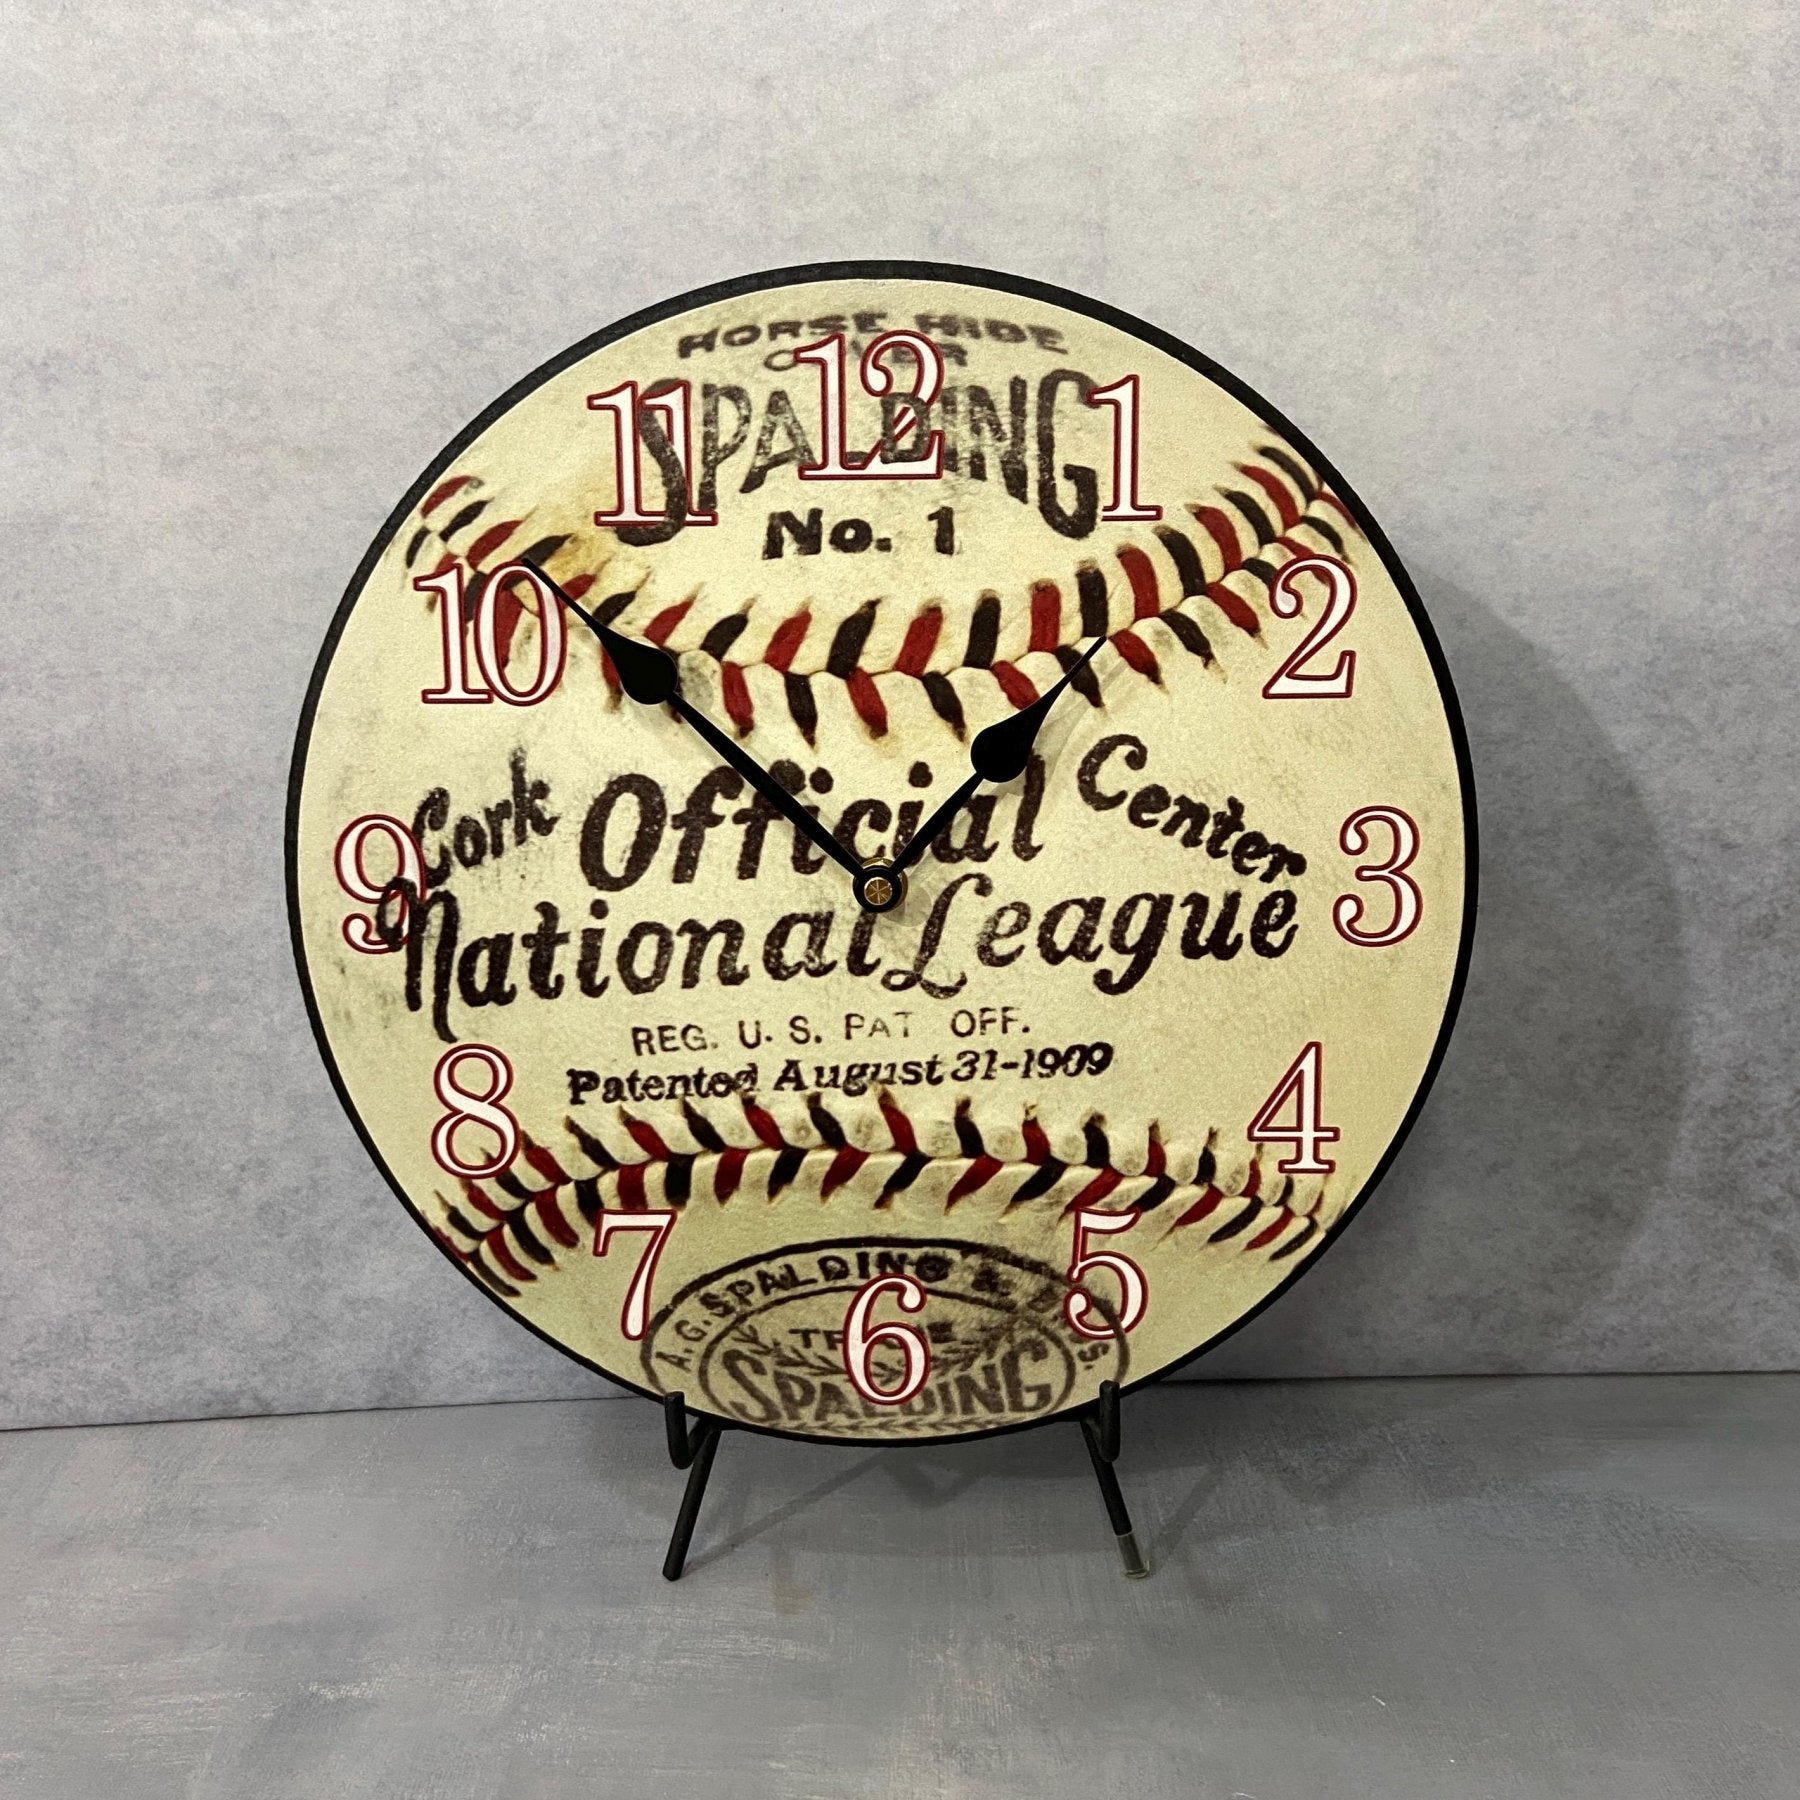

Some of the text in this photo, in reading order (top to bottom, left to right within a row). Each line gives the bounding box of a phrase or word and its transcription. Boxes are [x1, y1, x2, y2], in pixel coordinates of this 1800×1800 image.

[677, 312, 1069, 359] HORSE HIDE
[793, 329, 944, 481] 12
[587, 380, 718, 527] 11
[1087, 375, 1163, 522] 1
[760, 504, 962, 561] No. 1
[413, 562, 568, 707] 10
[1262, 553, 1358, 699] 2
[410, 745, 559, 889] Cork
[580, 753, 1044, 892] Official
[1077, 733, 1307, 884] Center
[1332, 805, 1424, 948] 3
[333, 813, 428, 956] 9
[375, 872, 1299, 1044] National League
[631, 1005, 1031, 1057] REG. U. S. PAT OFF.
[773, 1053, 945, 1098] August
[430, 1043, 521, 1180] 8
[1247, 1041, 1341, 1175] 4
[592, 1208, 678, 1341] 7
[842, 1273, 934, 1406] 6
[1063, 1206, 1149, 1341] 5
